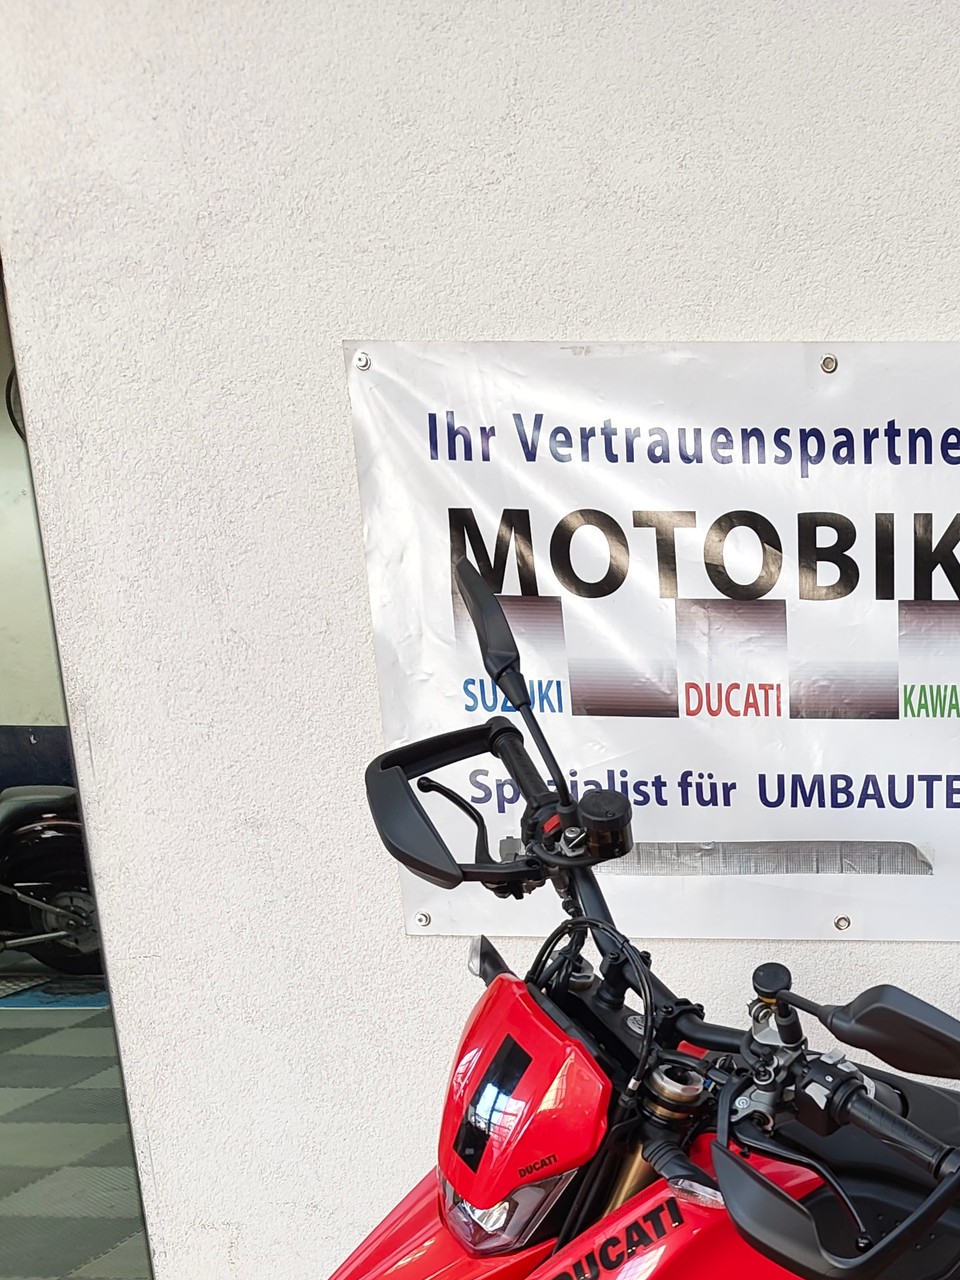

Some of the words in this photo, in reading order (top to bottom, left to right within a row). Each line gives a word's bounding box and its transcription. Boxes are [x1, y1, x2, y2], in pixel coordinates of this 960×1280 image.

[428, 411, 497, 461] Ihr
[685, 682, 783, 718] DUCATI
[677, 769, 738, 809] für
[518, 1154, 558, 1178] DUCATI
